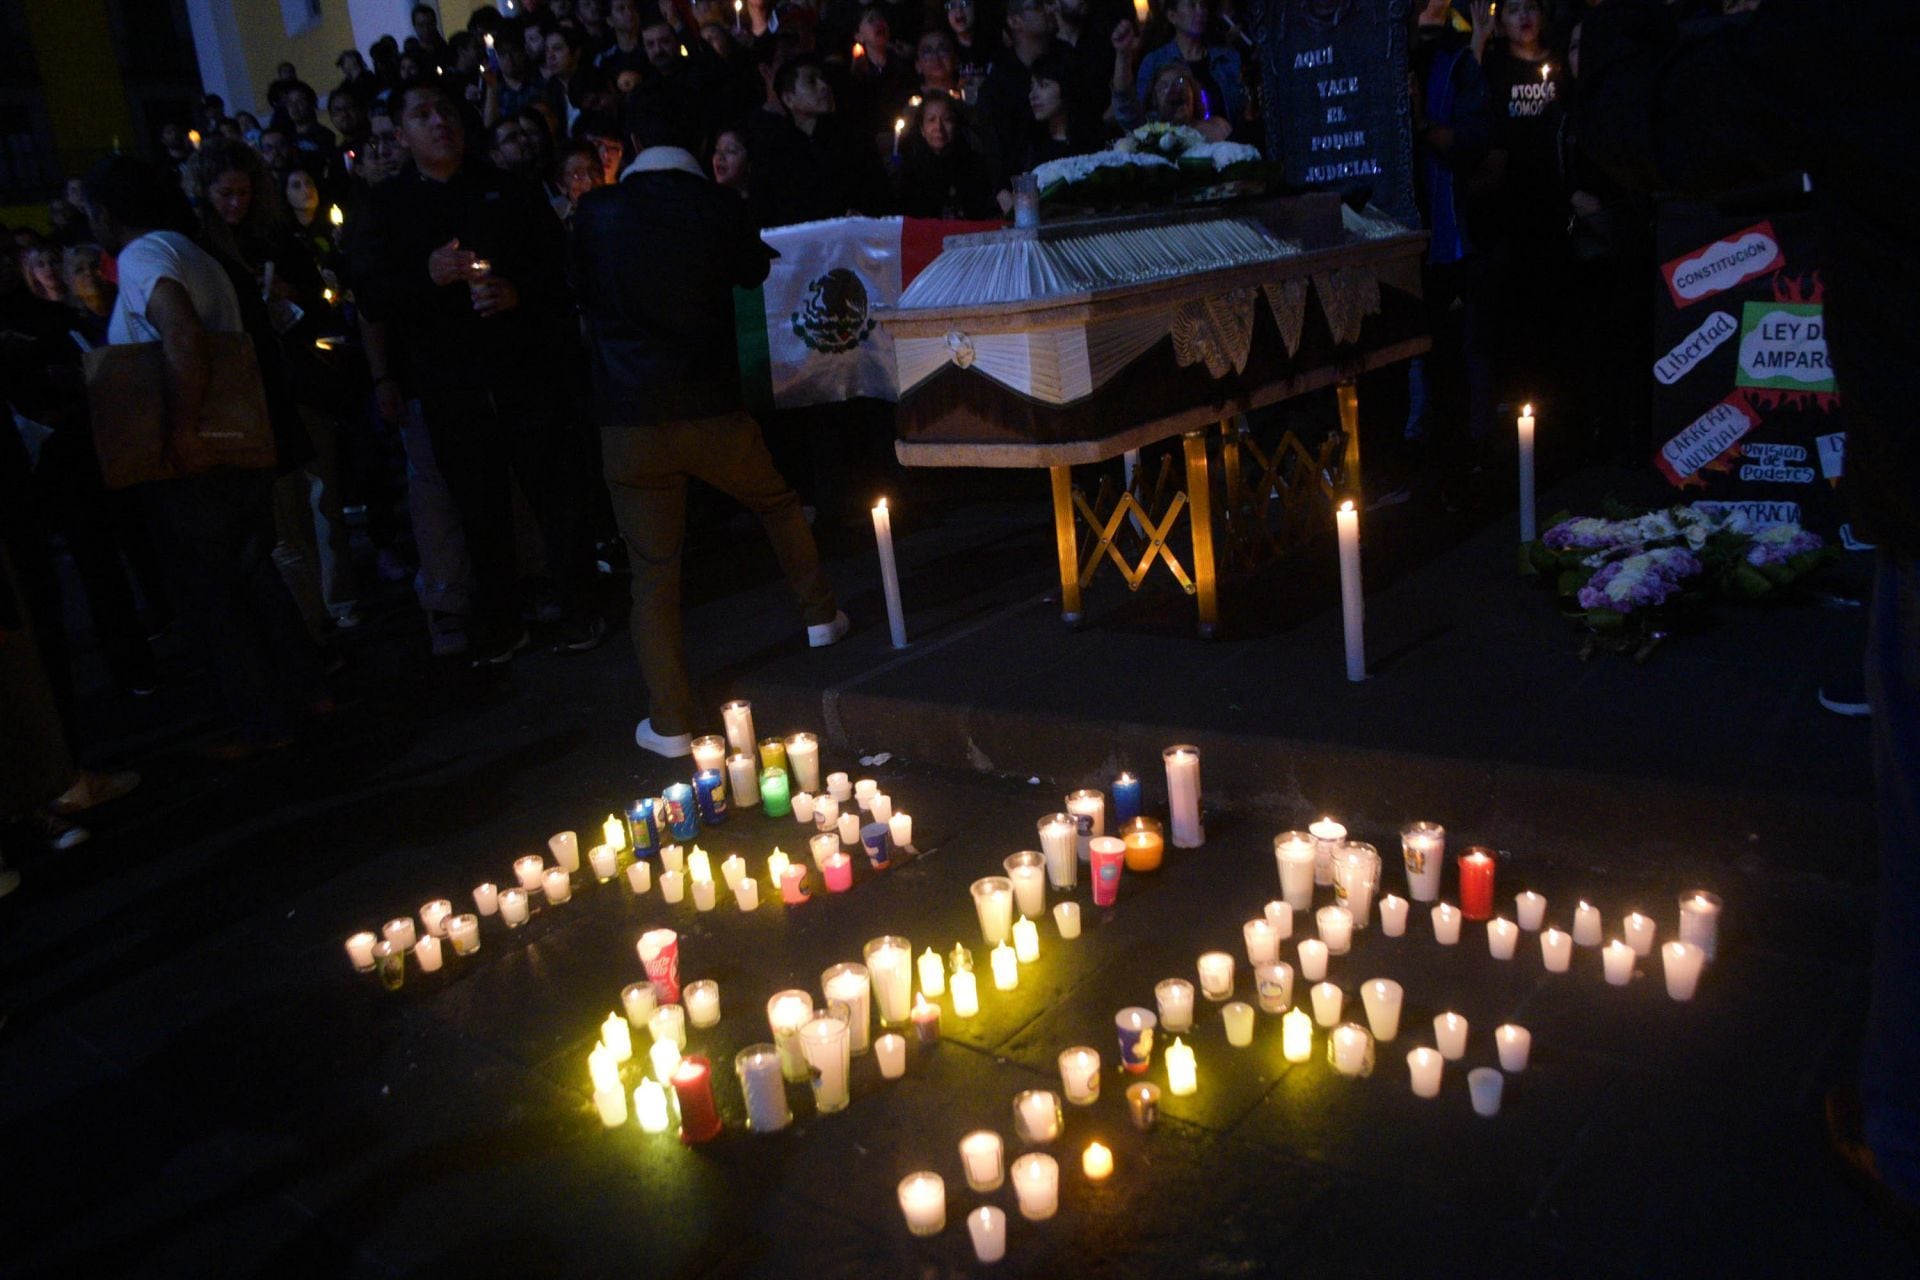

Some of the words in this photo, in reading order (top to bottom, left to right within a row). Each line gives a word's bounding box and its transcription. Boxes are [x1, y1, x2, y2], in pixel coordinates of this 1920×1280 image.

[1317, 76, 1359, 97] YACE
[1327, 106, 1346, 124] EL
[1311, 131, 1366, 151] PODER
[1763, 323, 1801, 340] LEY
[1680, 425, 1747, 477] JUDICIAL
[1763, 455, 1783, 467] de
